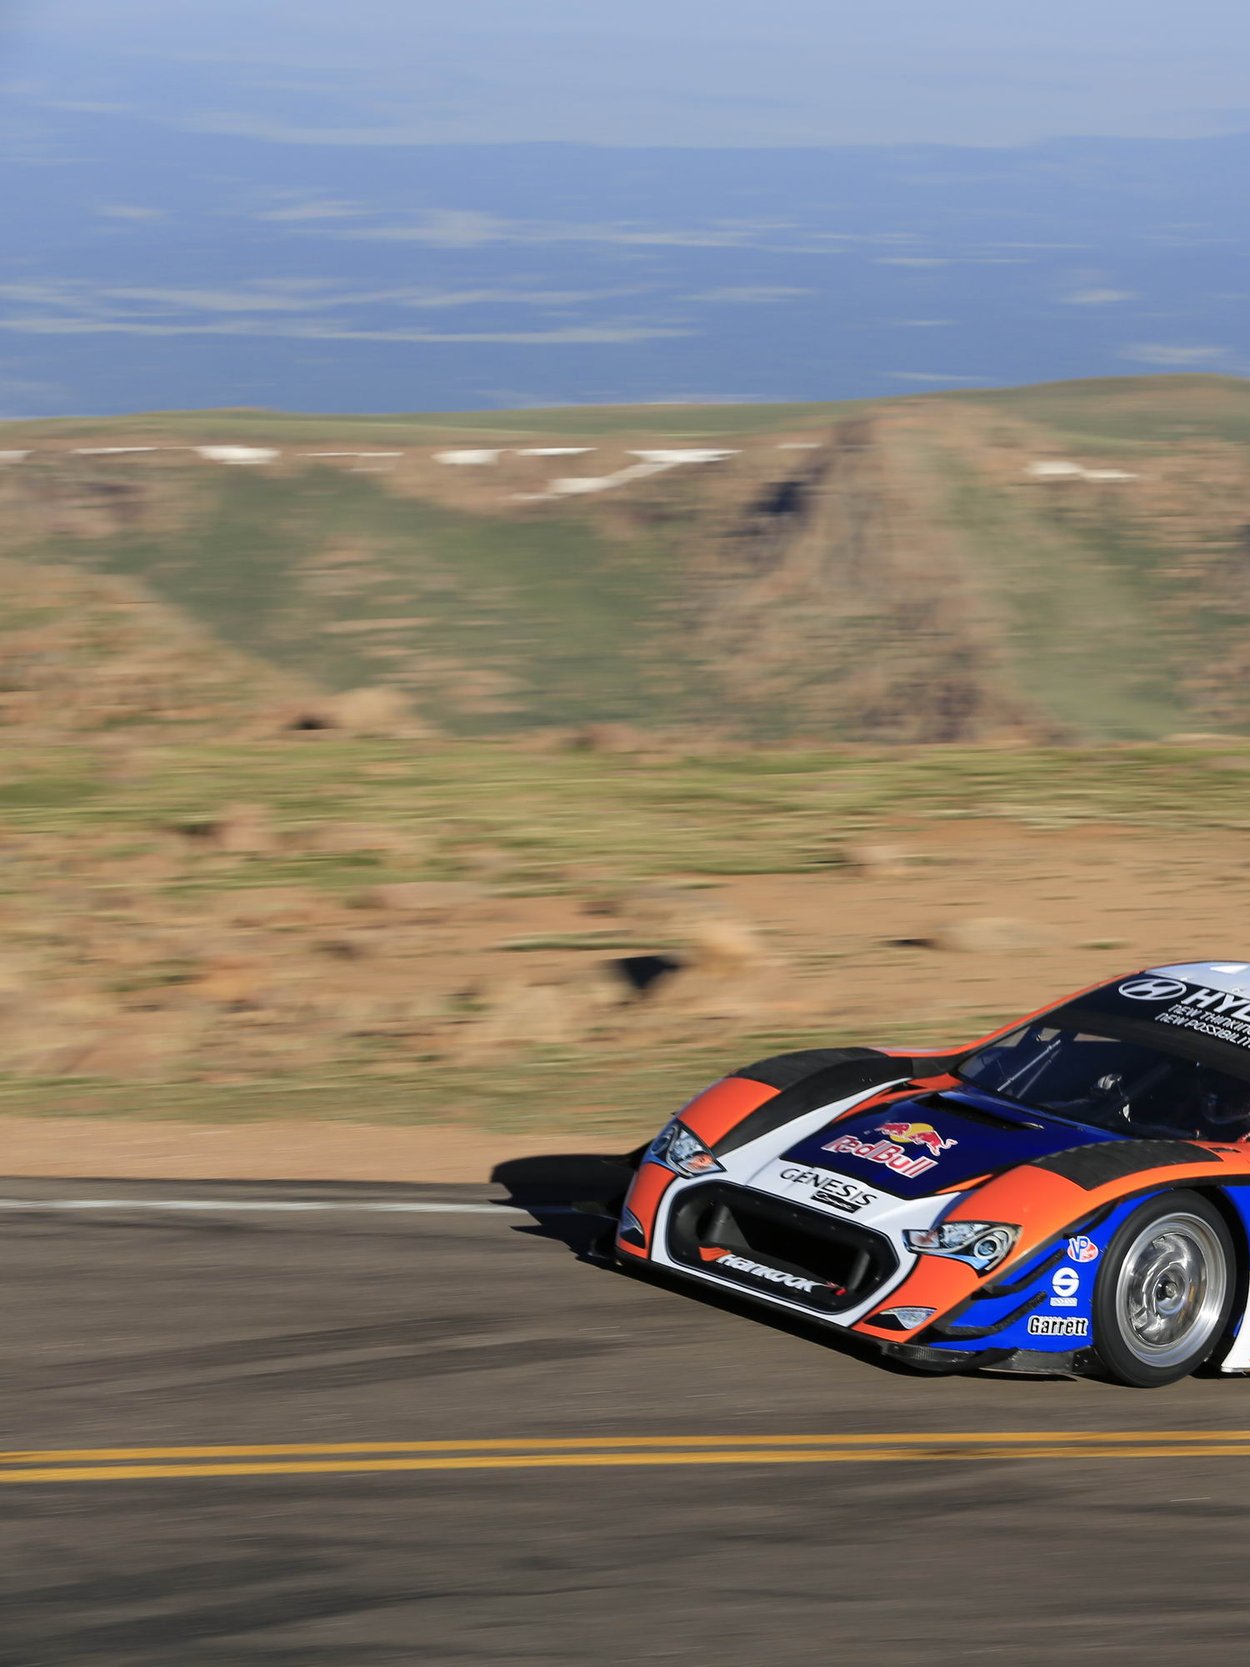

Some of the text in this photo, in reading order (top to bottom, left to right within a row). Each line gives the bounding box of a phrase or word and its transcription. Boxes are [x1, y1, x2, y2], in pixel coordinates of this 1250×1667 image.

[1168, 1004, 1202, 1018] NEW
[1155, 1013, 1190, 1027] NEW
[780, 1168, 877, 1206] GENESIS
[1029, 1316, 1087, 1335] Garrett
